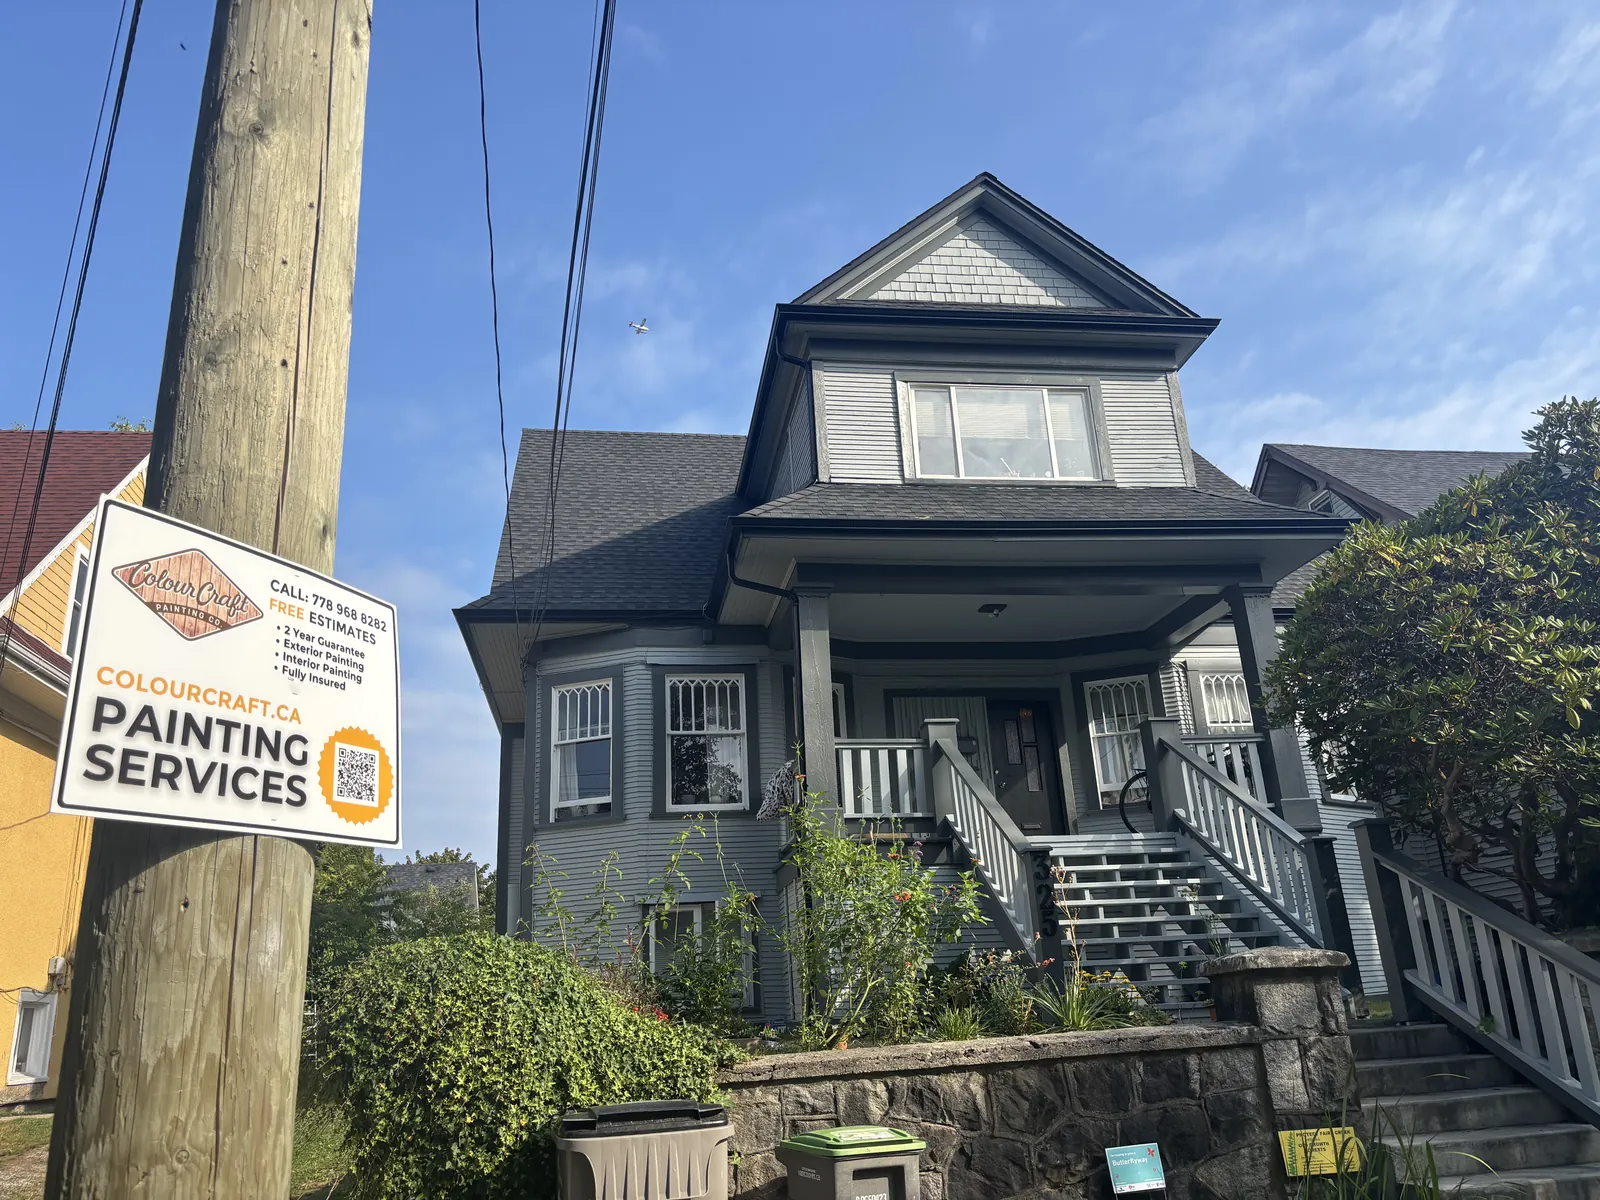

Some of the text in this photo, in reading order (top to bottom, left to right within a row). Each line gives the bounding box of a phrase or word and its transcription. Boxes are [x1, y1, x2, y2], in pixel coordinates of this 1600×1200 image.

[156, 604, 223, 628] PAINTING CO.
[269, 597, 376, 645] FREE ESTIMATES
[270, 579, 387, 632] CALL: 778 968 8282
[283, 638, 364, 673] Exterior Painting
[284, 625, 365, 659] 2 Year Guarantee
[282, 665, 346, 691] Fully Insured
[283, 652, 362, 685] Interior Painting
[96, 666, 302, 724] COLOURCRAFT.CA
[92, 695, 309, 766] PAINTING
[83, 743, 307, 807] SERVICES
[1112, 1157, 1148, 1166] Butterflyway
